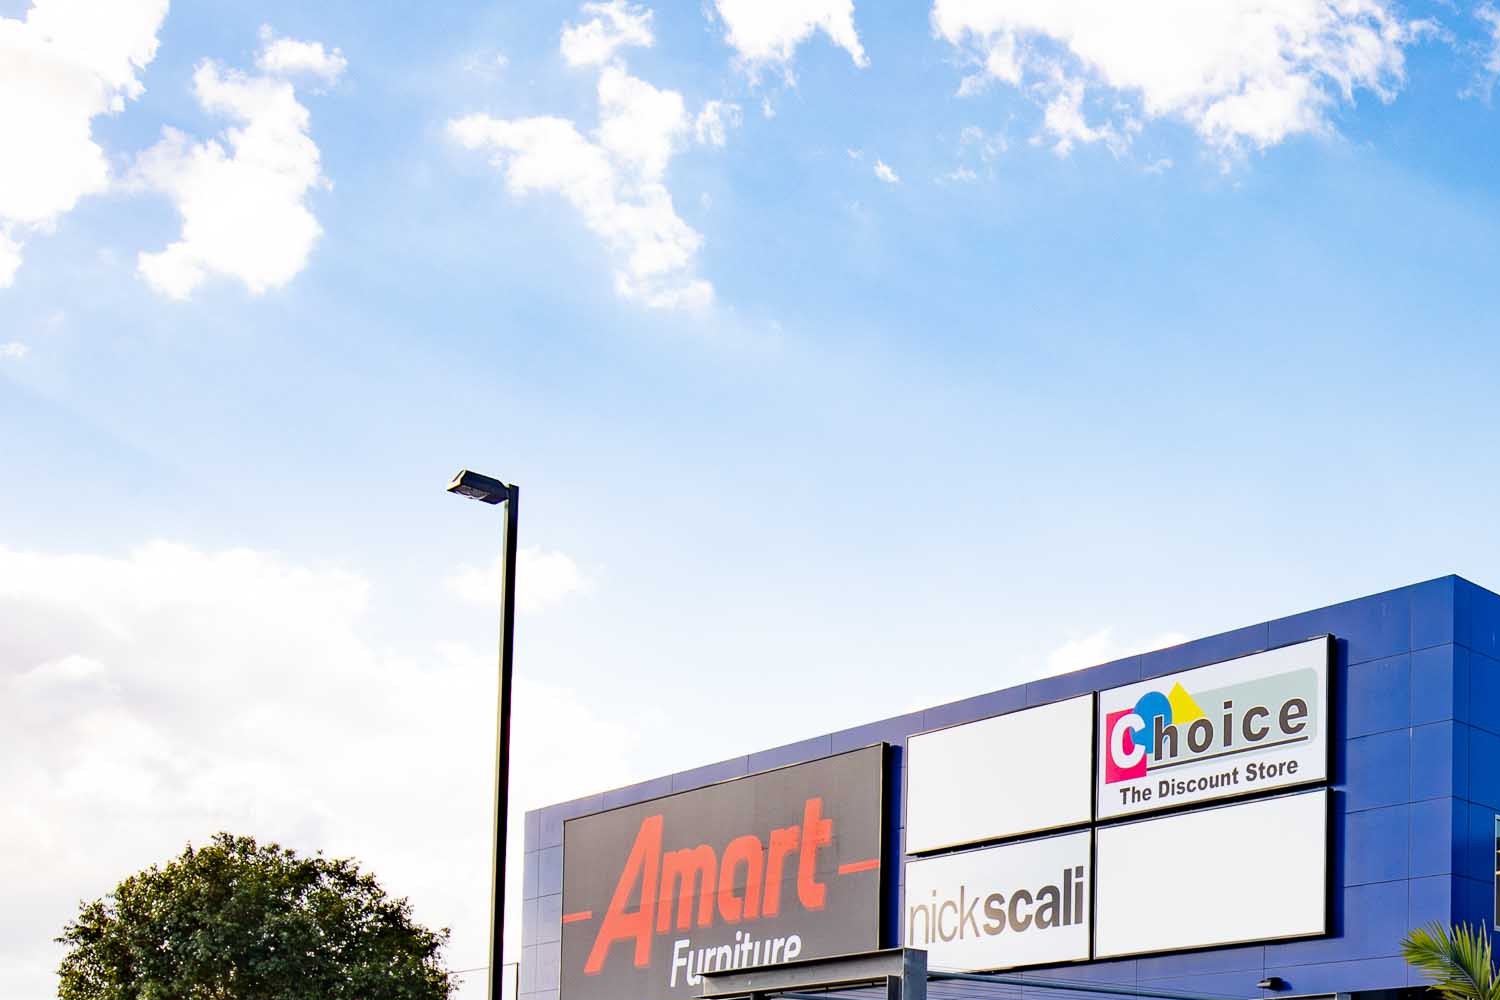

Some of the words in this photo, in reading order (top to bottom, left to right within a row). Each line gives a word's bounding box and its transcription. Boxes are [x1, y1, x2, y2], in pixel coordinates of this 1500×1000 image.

[1110, 697, 1308, 769] Choice
[1120, 785, 1152, 805] The
[1158, 767, 1239, 798] Discount
[1246, 759, 1298, 782] Store
[584, 796, 833, 976] Amart
[910, 865, 1084, 946] nickscali
